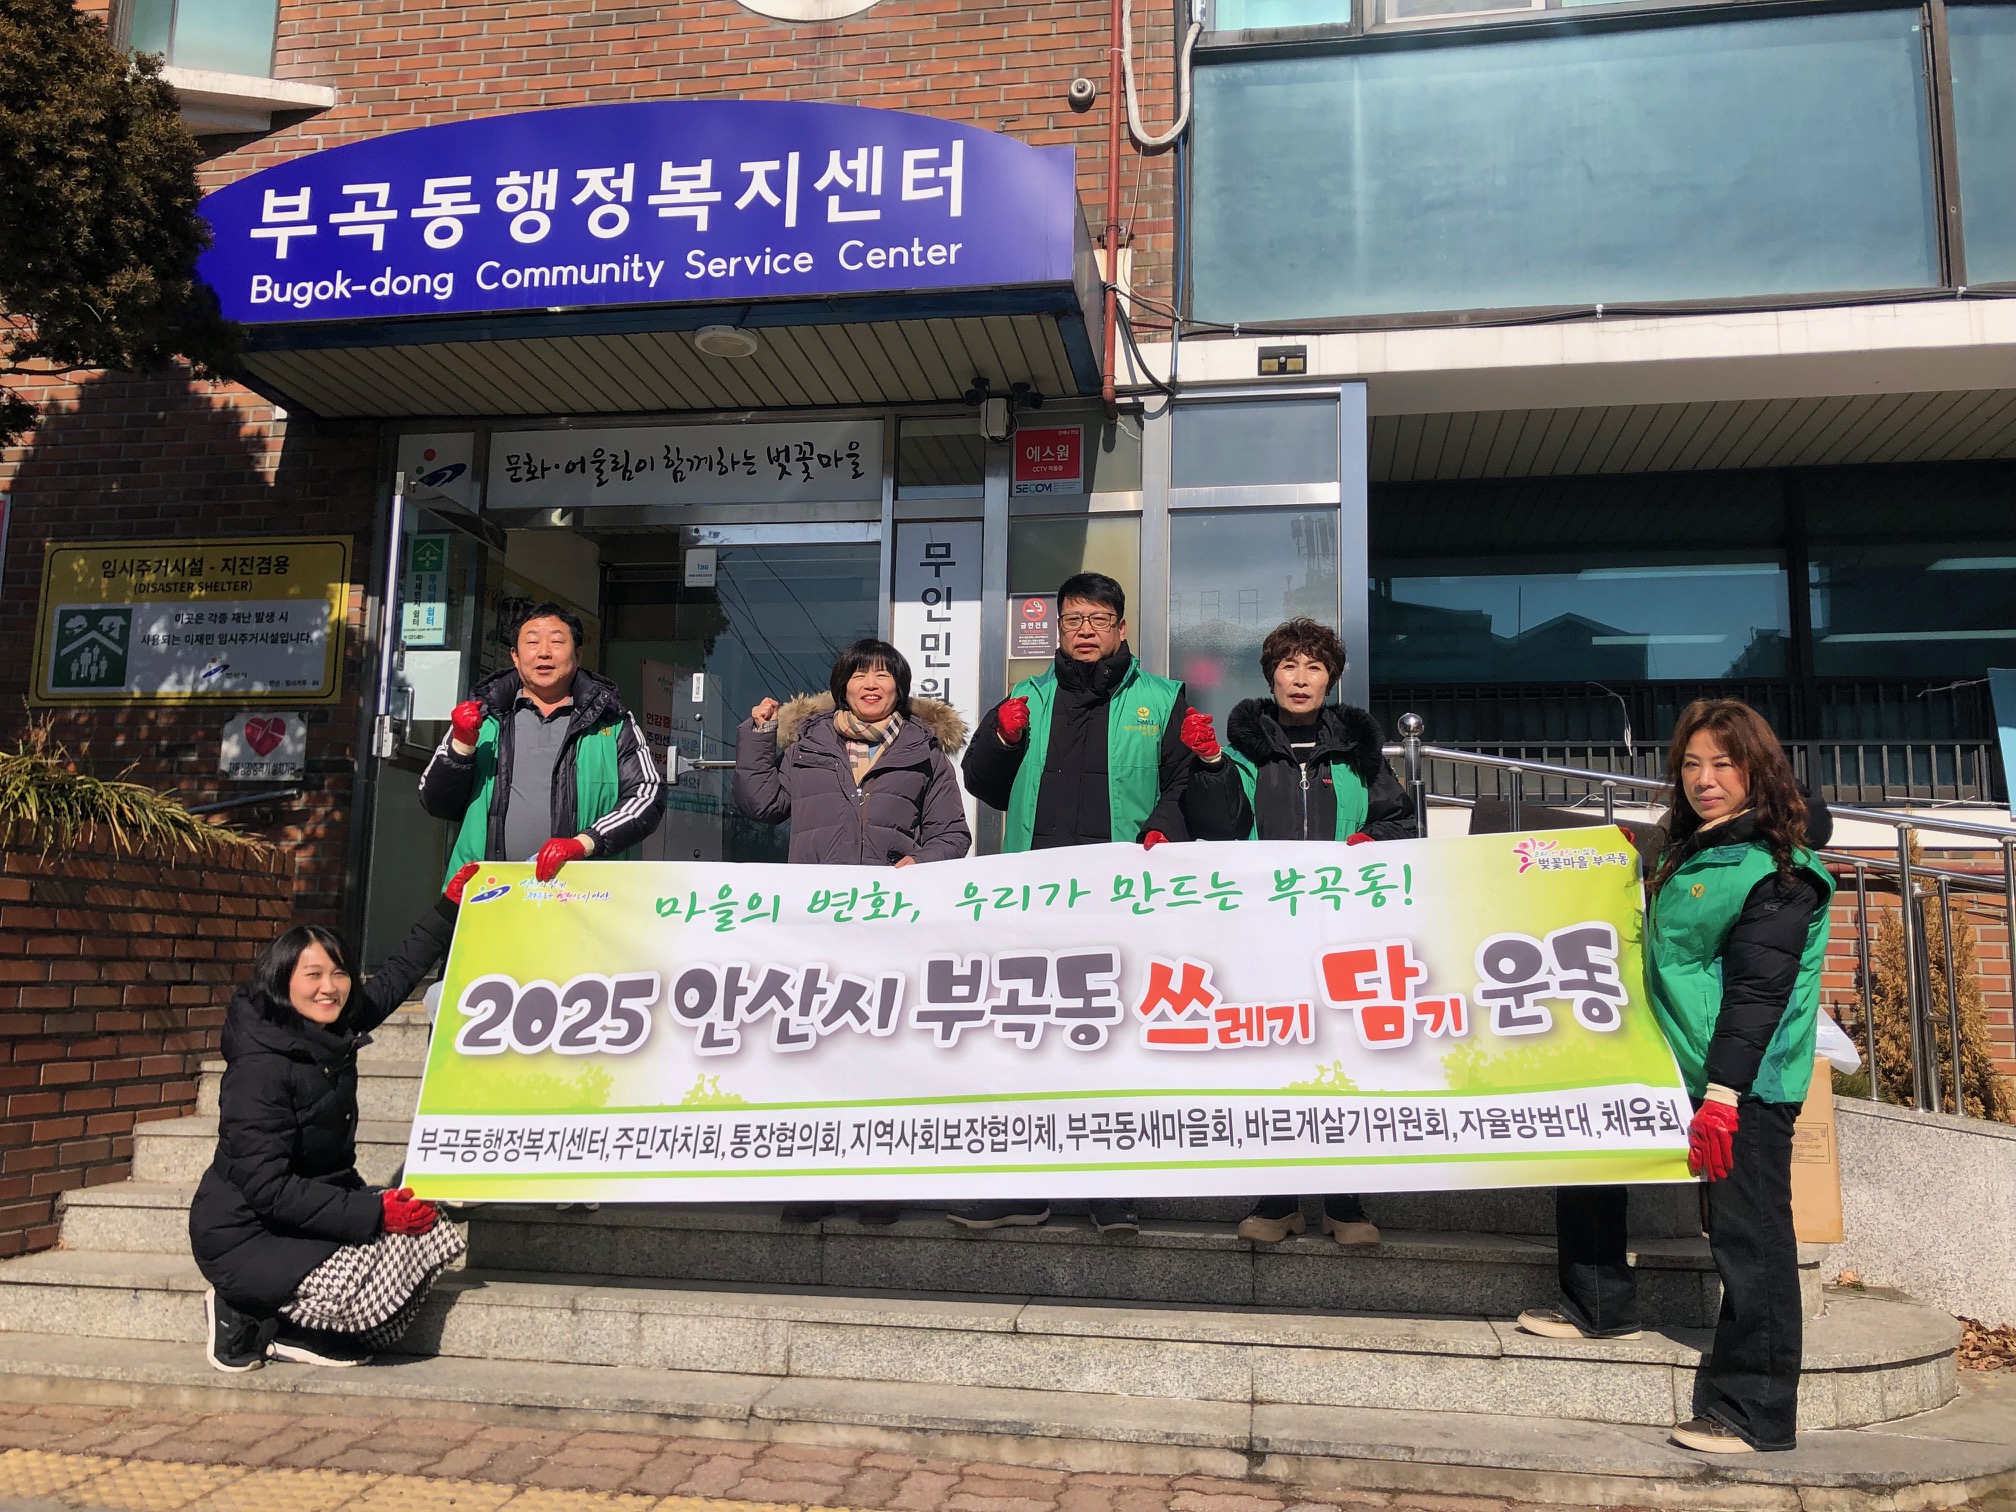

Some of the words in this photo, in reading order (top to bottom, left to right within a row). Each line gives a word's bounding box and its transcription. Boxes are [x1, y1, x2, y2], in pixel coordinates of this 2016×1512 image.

[249, 138, 966, 260] 부곡동행정복지센터
[250, 268, 455, 310] Bugok-dong
[476, 253, 666, 291] Community
[684, 245, 814, 280] Service
[838, 236, 964, 272] Center
[664, 444, 758, 483] 함께하는
[767, 440, 865, 483] 벚꽃마을
[1026, 444, 1069, 462] 에스원
[1032, 465, 1048, 473] CCTV
[1015, 482, 1052, 494] SECOM
[101, 556, 205, 579] 임시주거시설
[220, 555, 290, 576] 지진겸용
[134, 581, 195, 595] (DISASTER
[197, 580, 253, 593] SHELTER)
[174, 612, 204, 625] 이곳은
[207, 611, 228, 624] 각종
[231, 611, 253, 624] 재난
[255, 610, 276, 624] 발생
[279, 612, 289, 623] 시
[426, 606, 436, 627] 쉼터
[140, 633, 181, 646] 사용되는
[185, 632, 215, 646] 이재민
[218, 630, 314, 646] 임시주거시설입니다.
[1136, 718, 1154, 726] SMU
[1538, 855, 1589, 870] 벚꽃마을
[1592, 851, 1629, 867] 부곡동
[655, 884, 779, 932] 마을의
[807, 883, 921, 924] 변화,
[954, 879, 1091, 921] 우리가
[1109, 870, 1244, 915] 만드는
[1267, 862, 1414, 917] 부곡동!
[461, 977, 656, 1048] 2025
[672, 964, 902, 1049] 안산시
[915, 952, 1120, 1044] 부곡동
[1139, 960, 1311, 1045] 쓰레기
[1321, 938, 1464, 1041] 담기
[1480, 927, 1623, 1026] 운동
